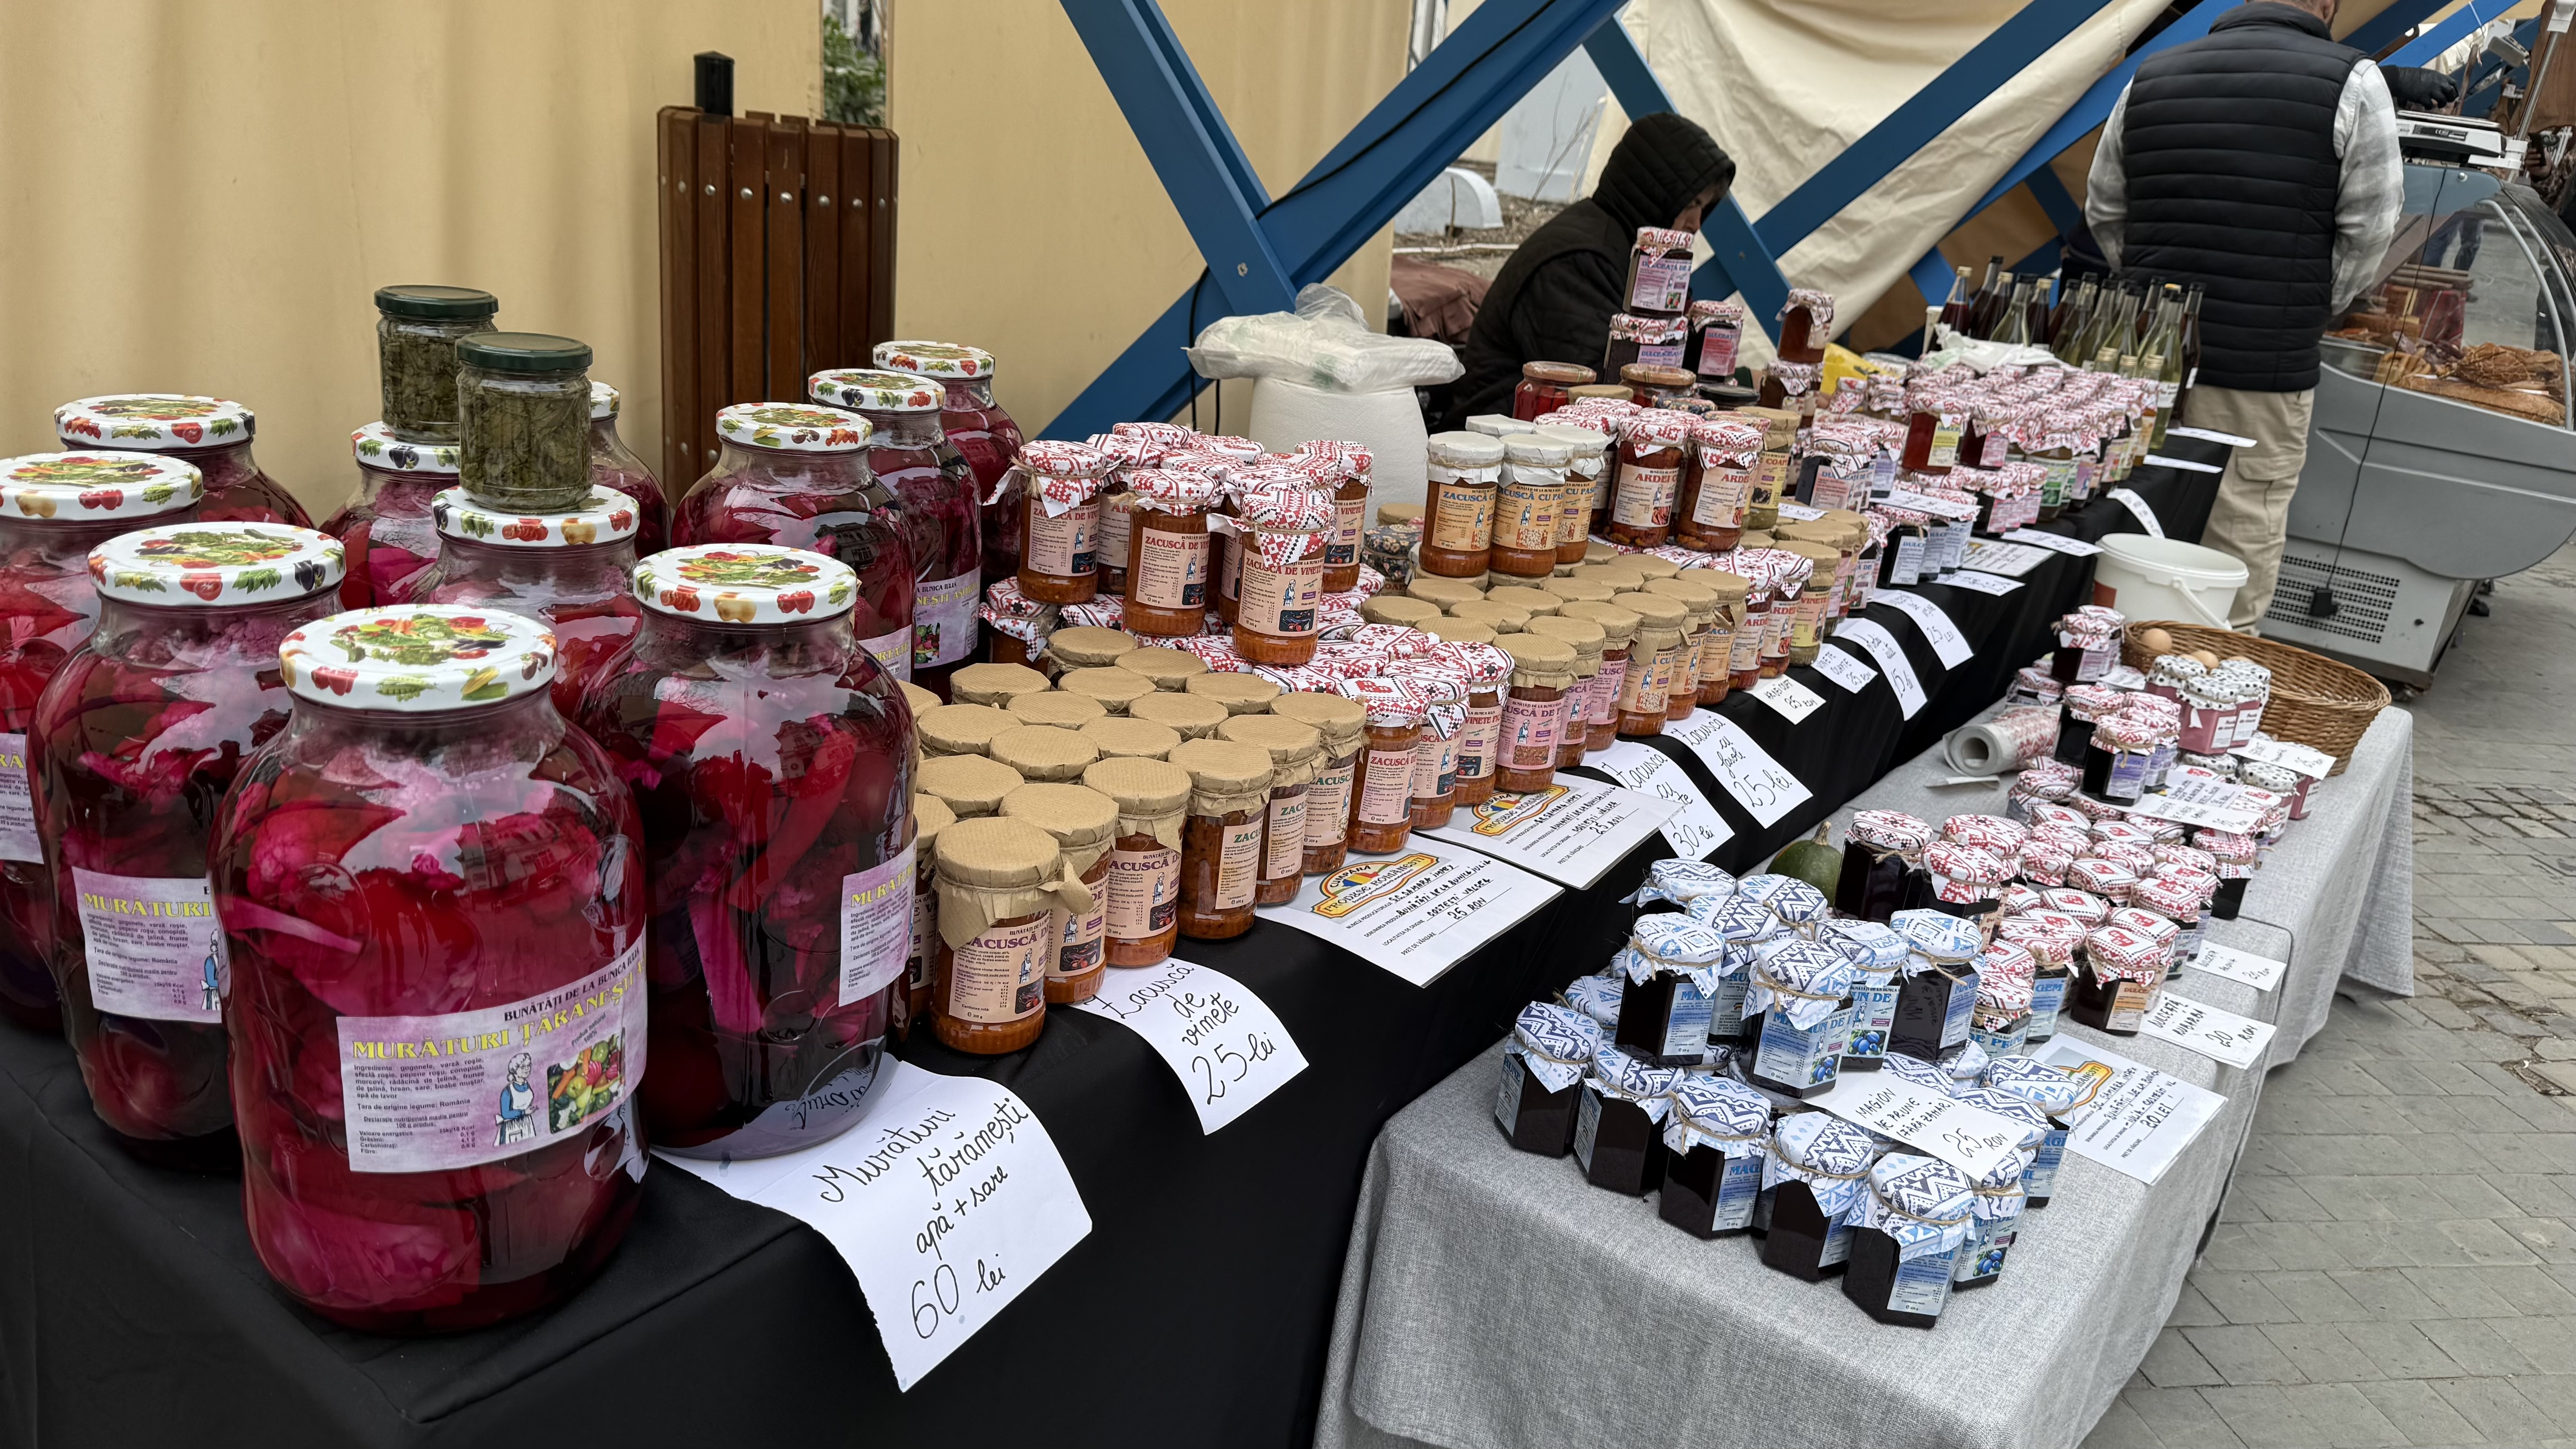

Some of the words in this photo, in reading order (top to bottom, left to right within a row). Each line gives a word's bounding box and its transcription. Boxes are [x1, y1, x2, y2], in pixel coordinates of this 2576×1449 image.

[1635, 473, 1670, 483] ARDEI
[1444, 491, 1487, 502] ZACUSCĂ
[1075, 512, 1086, 520] DE
[1341, 505, 1360, 515] VINETE
[1145, 536, 1186, 550] ZACUSCĂ
[1285, 567, 1297, 575] DE
[1301, 565, 1322, 575] VINETE
[917, 593, 949, 609] NEȘTI
[1927, 626, 1942, 644] 25
[874, 642, 910, 662] ORTATE
[1784, 695, 1802, 709] 25
[1466, 716, 1491, 724] VINETE
[1719, 736, 1734, 750] cu
[1370, 755, 1410, 766] ZACUSCĂ
[1733, 775, 1776, 808] 25
[1762, 768, 1793, 791] lei
[1280, 800, 1307, 816] ZACU
[1589, 822, 1609, 835] 25
[1673, 823, 1700, 856] 30
[1699, 824, 1715, 841] lei
[1109, 856, 1169, 871] ACUSCĂ
[1402, 877, 1431, 898] SAMARA
[84, 893, 212, 917] MURĂTURI
[1323, 886, 1371, 912] PRODUSE
[1447, 907, 1467, 920] 25
[1467, 897, 1487, 912] RON
[967, 931, 1037, 949] ACUSCĂ
[504, 994, 561, 1021] BUNĂTĂȚI
[566, 987, 579, 1001] DE
[582, 981, 595, 994] LA
[598, 961, 626, 986] BUNICA
[1083, 963, 1195, 1019] Zacuscă
[2035, 984, 2063, 992] GEM
[1164, 993, 1205, 1018] de
[1872, 993, 1891, 1003] DE
[353, 1029, 510, 1059] MURĂTURI
[519, 971, 634, 1047] ȚĂRĂNEȘTI
[1830, 1017, 1845, 1029] DE
[2204, 1030, 2234, 1048] 20
[1192, 1043, 1248, 1105] 25
[1248, 1032, 1277, 1062] lei
[1504, 1058, 1521, 1082] RUNE
[1583, 1089, 1598, 1117] RUNE
[1873, 1119, 1894, 1130] DE
[1887, 1097, 1920, 1122] PRUNE
[2139, 1115, 2161, 1128] 20
[1943, 1127, 1982, 1158] 25
[1983, 1133, 2008, 1151] RON
[812, 1106, 956, 1203] Murături
[915, 1201, 955, 1261] apă
[973, 1165, 1008, 1208] sare
[911, 1263, 960, 1339] 60
[975, 1253, 1006, 1294] lei
